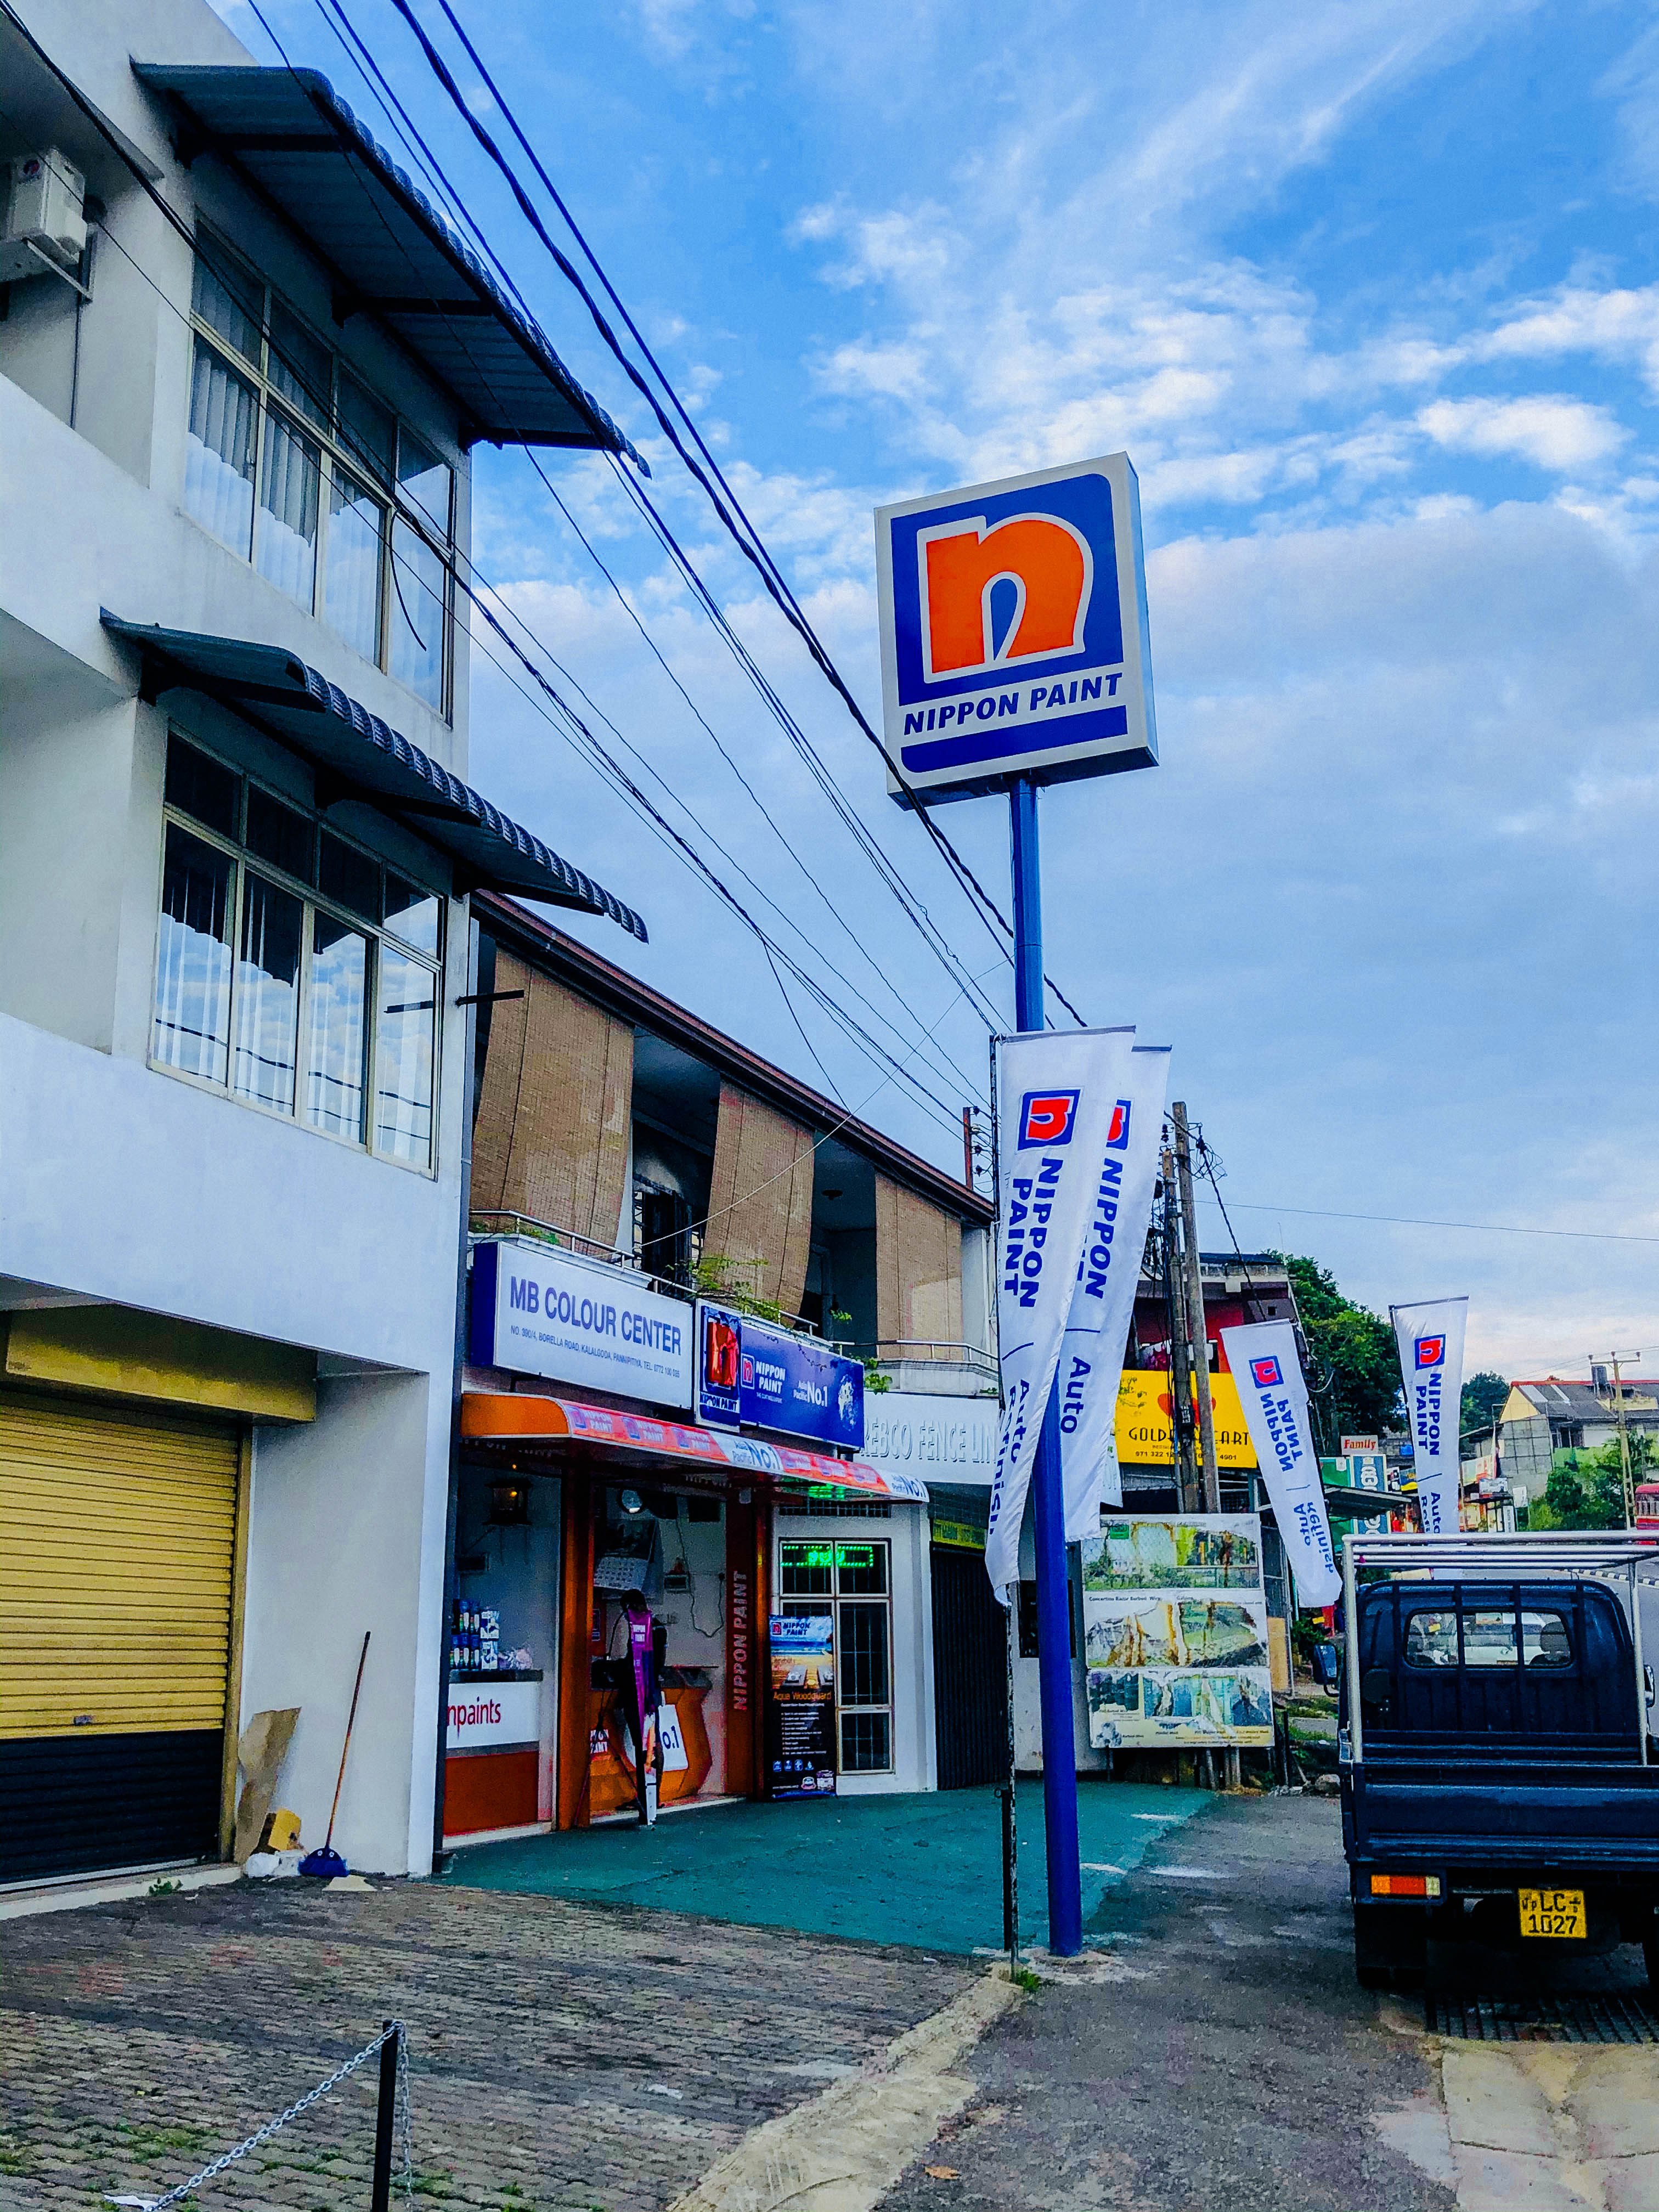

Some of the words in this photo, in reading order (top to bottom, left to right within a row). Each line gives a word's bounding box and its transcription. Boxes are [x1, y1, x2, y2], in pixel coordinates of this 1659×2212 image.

[904, 692, 1019, 736] NIPPON
[1030, 672, 1123, 711] PAINT
[1004, 1177, 1033, 1295] PAINT
[1019, 1158, 1064, 1308] NIPPON
[1085, 1158, 1123, 1299] NIPPON
[510, 1276, 539, 1313] MB
[545, 1287, 616, 1337] COLOUR
[621, 1311, 681, 1356] CENTER
[539, 1332, 563, 1347] BORELLA
[755, 1361, 786, 1381] NIPPON
[759, 1376, 783, 1394] PAINT
[721, 1398, 737, 1412] PAINT
[807, 1381, 828, 1407] No.1
[1060, 1356, 1091, 1434] Auto
[1428, 1373, 1442, 1455] NIPPON
[1415, 1386, 1428, 1450] PAINT
[743, 1441, 780, 1470] No.1
[918, 1420, 966, 1463] FENCE
[1344, 1439, 1376, 1450] Family
[899, 1475, 927, 1498] No.1
[733, 1571, 747, 1629] PAINT
[733, 1634, 747, 1711] NIPPON
[1528, 1914, 1577, 1934] 1027
[1539, 1893, 1566, 1912] LC
